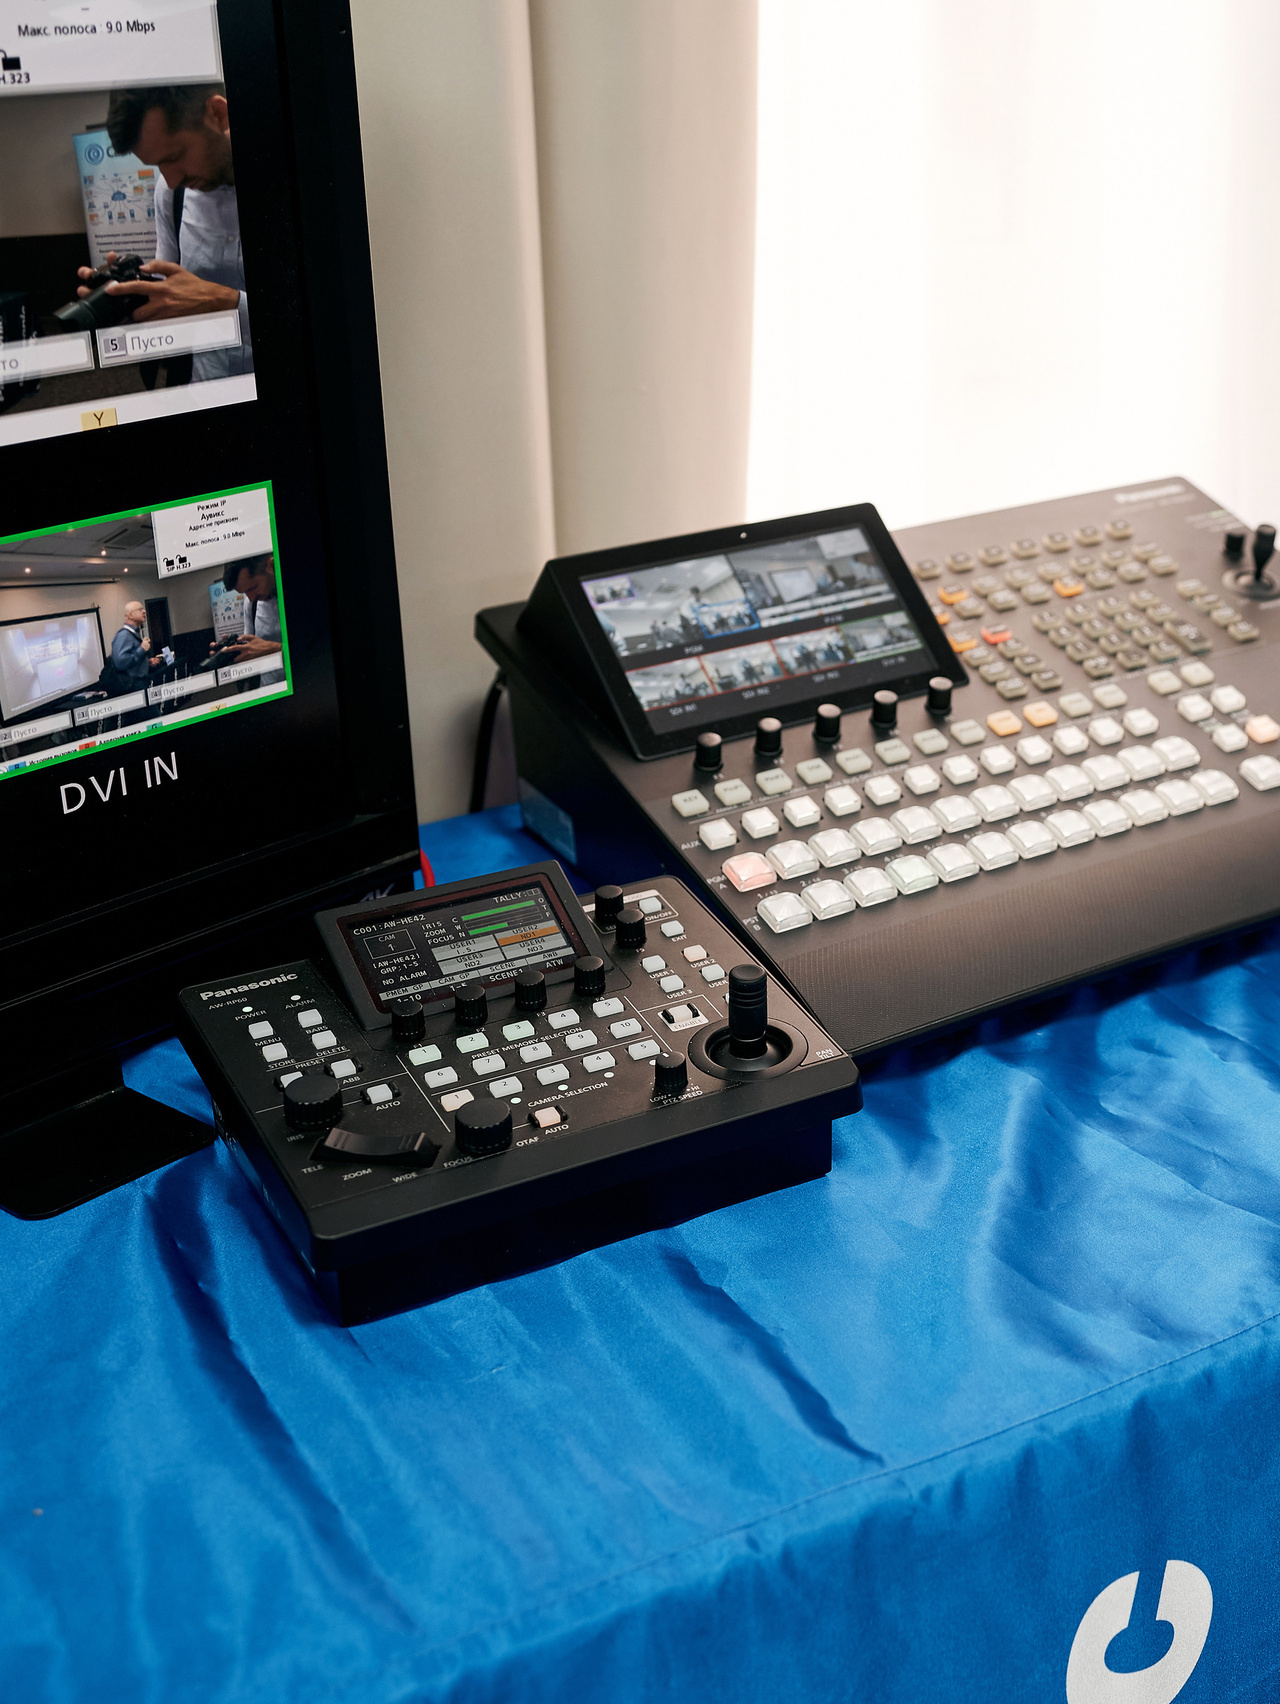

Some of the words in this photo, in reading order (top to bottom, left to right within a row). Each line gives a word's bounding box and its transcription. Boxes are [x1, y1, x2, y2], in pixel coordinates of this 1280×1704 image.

[54, 24, 97, 36] полоса
[106, 21, 123, 33] 9.0
[126, 19, 156, 33] Mbps
[110, 338, 119, 351] 5
[130, 333, 175, 352] Пусто
[93, 411, 104, 426] Y
[197, 502, 219, 512] Режим
[231, 666, 253, 677] Пусто
[162, 684, 185, 697] Пусто
[90, 705, 113, 717] Пусто
[13, 726, 37, 739] Пусто
[59, 766, 128, 815] DVI
[143, 751, 179, 789] IN
[680, 840, 702, 851] AUX
[706, 874, 727, 885] PGM
[644, 911, 673, 921] ON/OFF
[742, 915, 759, 926] PST
[421, 921, 443, 931] IRIS
[512, 924, 539, 935] USER2
[378, 934, 396, 943] CAM
[423, 928, 447, 938] ZOOM
[520, 931, 537, 940] ND1
[671, 934, 688, 942] EXIT
[427, 934, 455, 945] FOCUS
[449, 939, 477, 950] USER1
[519, 938, 546, 949] USER4
[388, 943, 395, 952] 1
[527, 945, 544, 953] ND3
[456, 953, 484, 964] USER3
[542, 951, 558, 960] AWB
[464, 960, 482, 969] ND2
[489, 962, 516, 973] SCENE
[545, 959, 564, 968] ATW
[690, 960, 710, 969] USER
[382, 978, 395, 986] NO
[399, 970, 428, 982] ALARM
[438, 976, 456, 985] CAM
[459, 972, 470, 980] GP
[649, 970, 669, 979] USER
[200, 973, 299, 1001] Panasonic
[708, 979, 728, 988] USER
[385, 987, 409, 998] PMEM
[396, 993, 422, 1003] 1-10
[666, 990, 686, 999] USER
[285, 998, 316, 1010] ALARM
[234, 1010, 267, 1021] POWER
[674, 1018, 704, 1030] ENABLE
[305, 1025, 329, 1035] BARS
[254, 1037, 282, 1047] MENU
[471, 1048, 501, 1060] PRESET
[501, 1038, 540, 1052] MEMORY
[539, 1027, 583, 1044] SELECTION
[315, 1046, 347, 1057] DELETE
[815, 1048, 833, 1056] PAN
[267, 1058, 297, 1069] STORE
[295, 1058, 326, 1070] PRESET
[342, 1076, 361, 1085] ABB
[527, 1094, 565, 1107] CAMERA
[564, 1082, 609, 1097] SELECTION
[650, 1094, 667, 1103] LOW
[662, 1097, 678, 1105] PTZ
[679, 1090, 704, 1101] SPEED
[375, 1101, 401, 1111] AUTO
[544, 1123, 570, 1135] AUTO
[287, 1133, 305, 1142] IRIS
[516, 1136, 540, 1148] OTAF
[443, 1155, 474, 1168] FOCUS
[301, 1164, 324, 1174] TELE
[342, 1168, 373, 1181] ZOOM
[392, 1171, 419, 1183] WIDE
